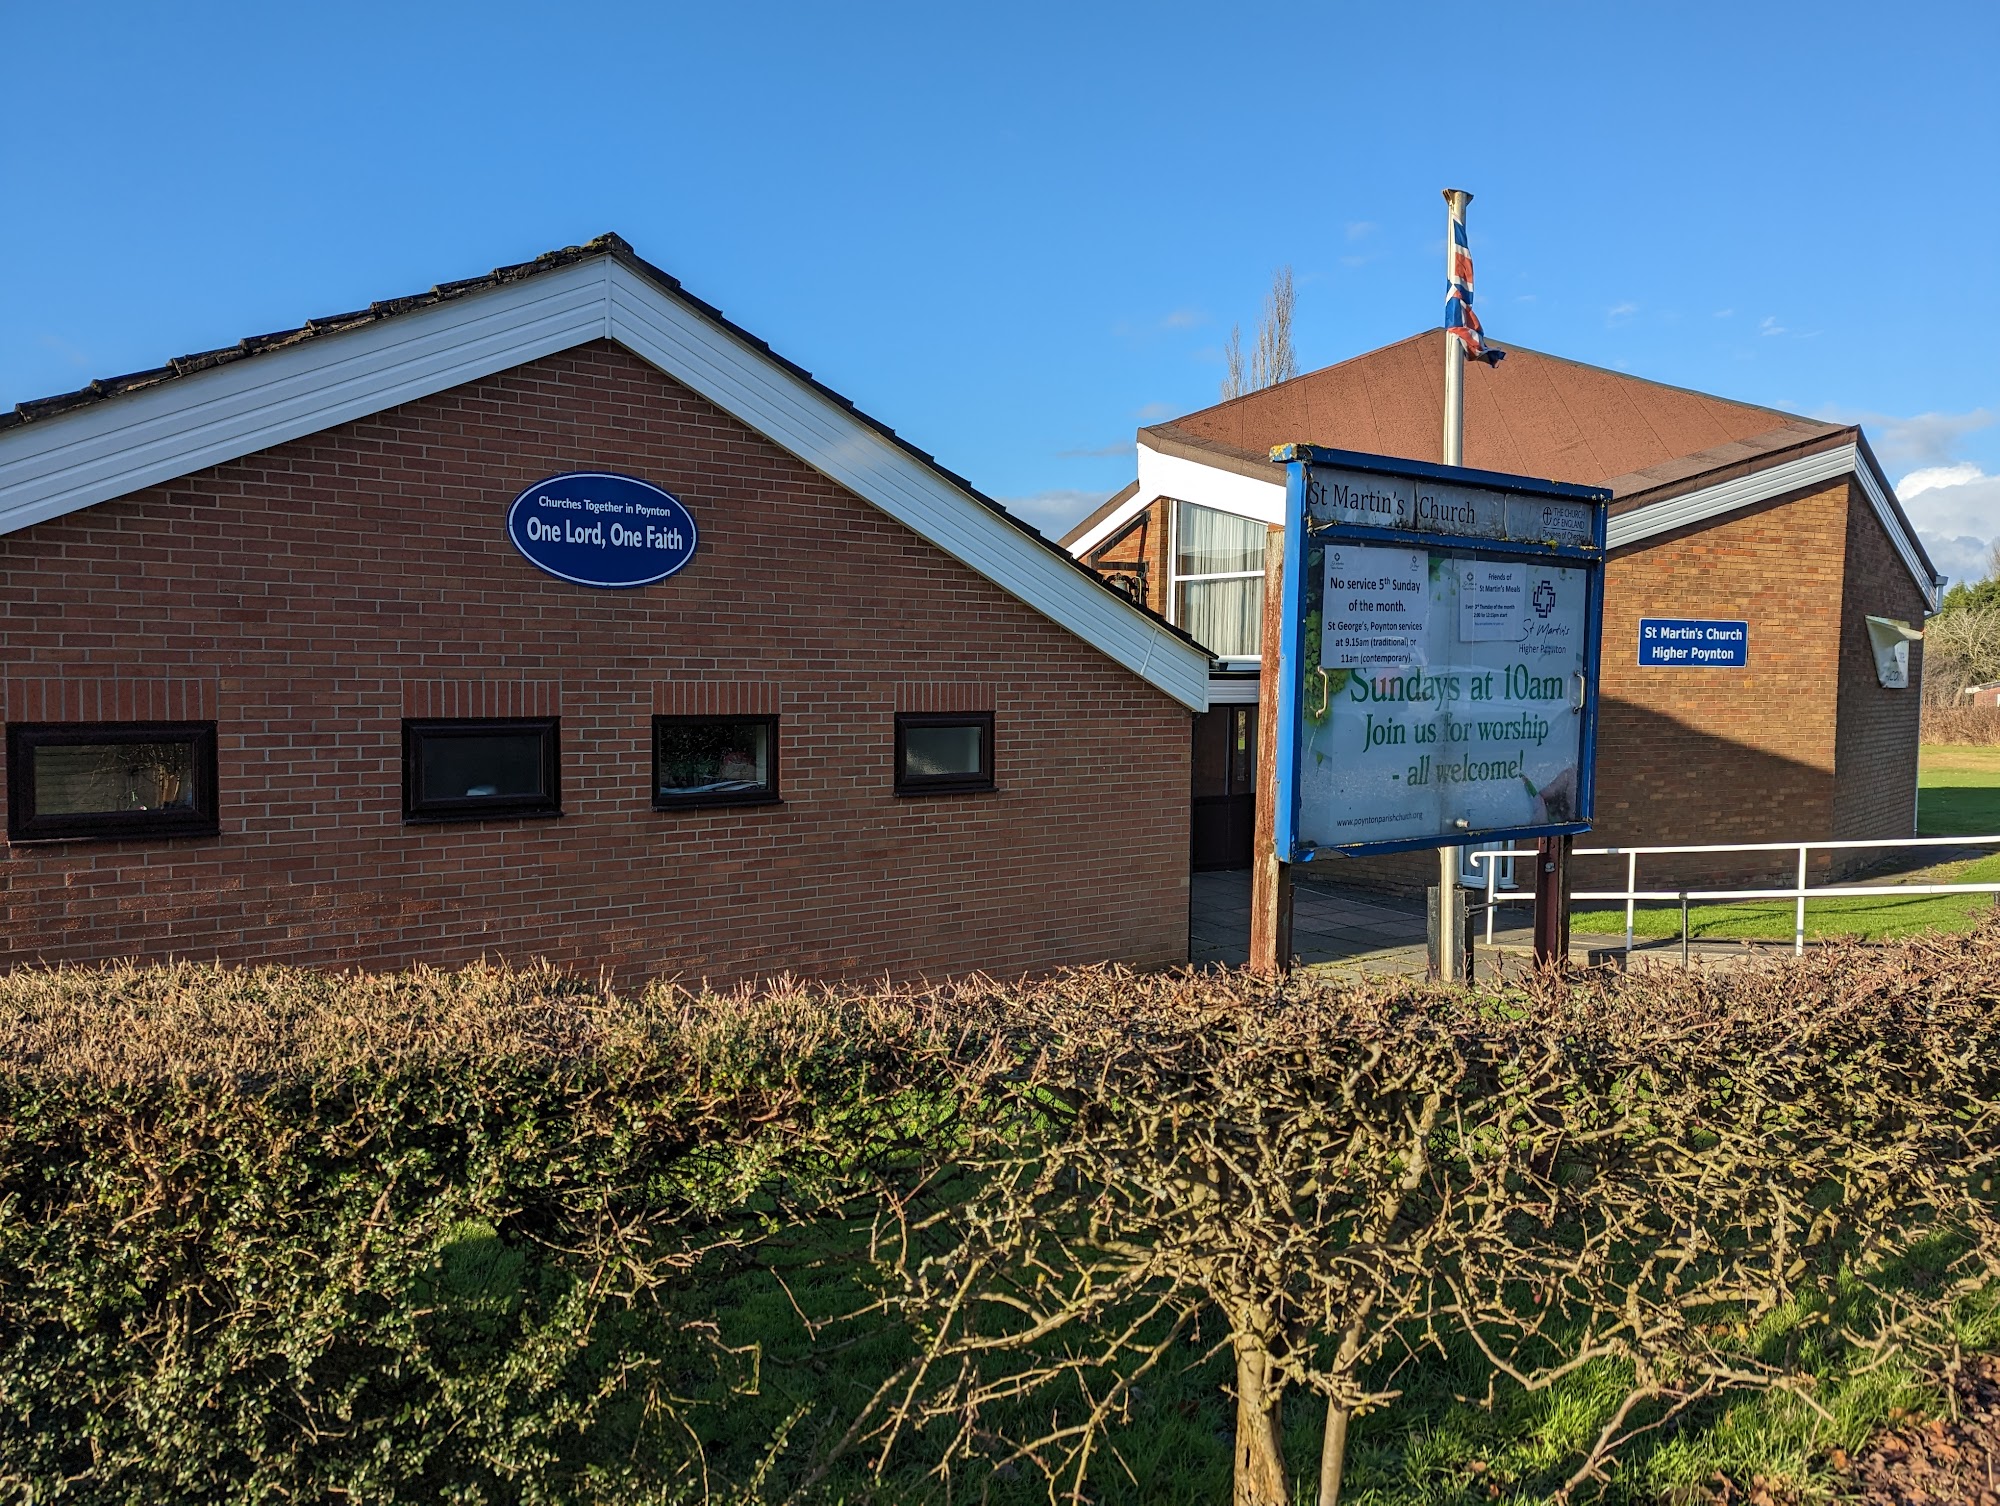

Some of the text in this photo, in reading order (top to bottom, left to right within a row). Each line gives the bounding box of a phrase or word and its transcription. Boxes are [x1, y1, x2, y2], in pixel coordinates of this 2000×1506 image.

[538, 495, 671, 518] Churches Together in Poynton
[1310, 481, 1475, 524] St Martin's Church
[1554, 507, 1586, 519] THE CHURCH
[1553, 517, 1585, 529] OF ENGLAND
[526, 516, 683, 550] One Lord, One Faith
[1488, 573, 1512, 581] Friends of
[1330, 577, 1421, 594] No service 5th Sunday
[1485, 585, 1505, 593] Martin's
[1505, 585, 1521, 593] Meals
[1348, 599, 1406, 612] of the month.
[1327, 621, 1423, 633] St George's, Poynton services
[1644, 626, 1743, 641] St Martin's Church
[1335, 638, 1343, 647] at
[1345, 638, 1369, 647] 9.15am
[1370, 636, 1409, 648] (traditional)
[1518, 643, 1539, 656] Higher
[1340, 652, 1413, 664] 11am (contemporary).
[1652, 646, 1734, 662] Higher Poynton
[1350, 663, 1564, 711] Sundays at 10am
[1363, 711, 1549, 753] Join us for worship
[1407, 755, 1431, 786] all
[1436, 749, 1525, 784] welcome!
[1336, 812, 1423, 827] www.poyntonparishchurch.org
